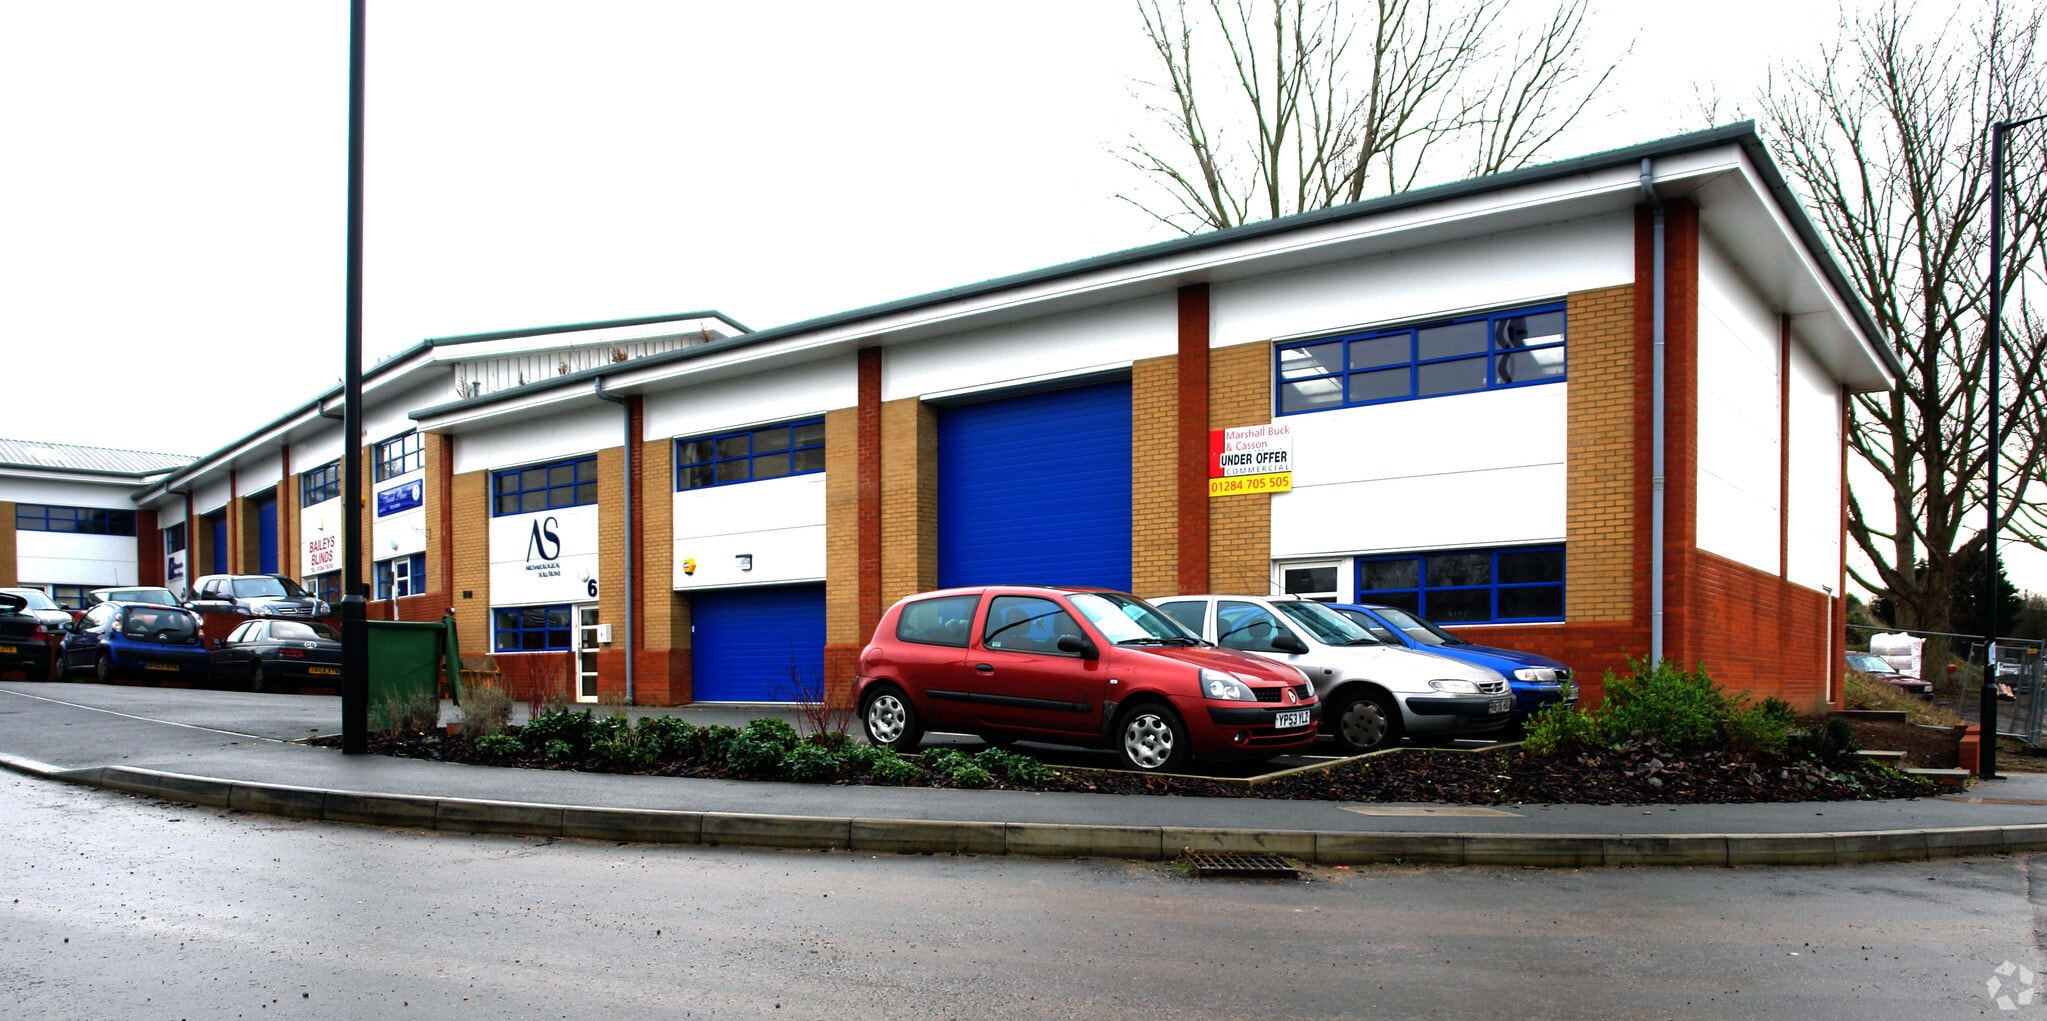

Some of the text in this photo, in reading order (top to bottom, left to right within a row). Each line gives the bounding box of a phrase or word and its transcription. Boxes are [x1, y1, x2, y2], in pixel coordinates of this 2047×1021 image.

[1226, 425, 1290, 440] Marshall Buck
[1226, 442, 1232, 451] &
[1236, 440, 1268, 451] Casson
[1221, 451, 1287, 466] UNDER OFFER
[1226, 464, 1289, 475] COMMERCIAL
[1211, 476, 1289, 492] 01284 705 505
[309, 535, 335, 553] BAILEYS
[311, 550, 334, 566] BLINDS
[587, 578, 598, 598] 6
[1279, 713, 1298, 726] YP53
